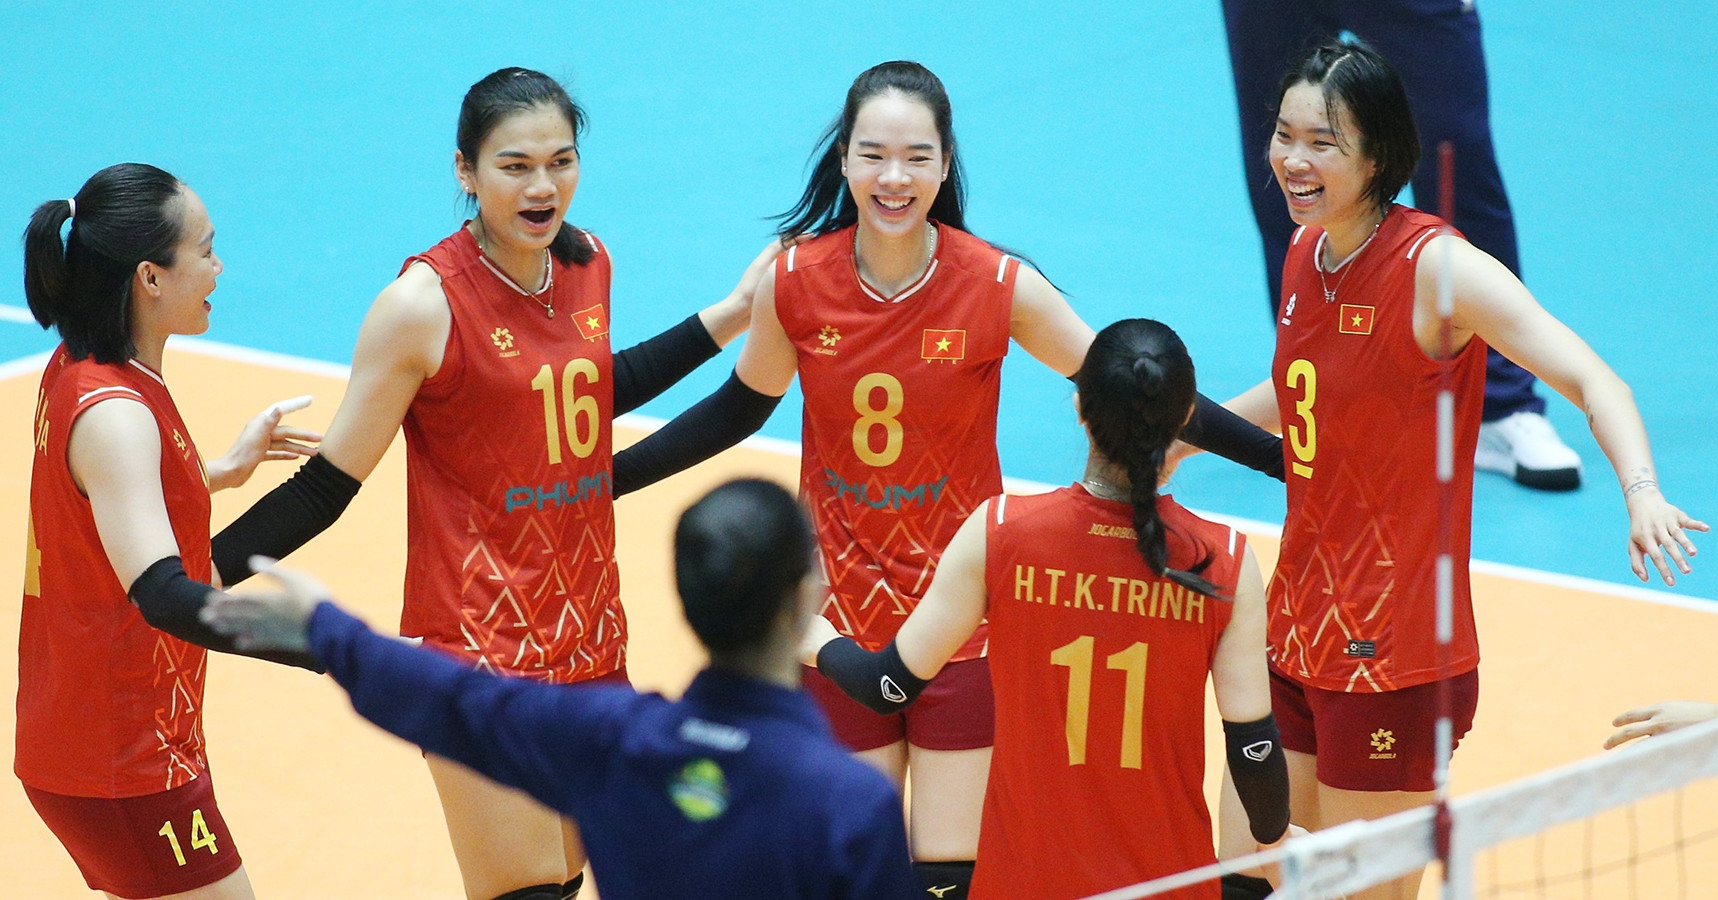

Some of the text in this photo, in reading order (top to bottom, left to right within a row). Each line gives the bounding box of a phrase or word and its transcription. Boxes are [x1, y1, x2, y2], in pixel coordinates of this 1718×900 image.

[531, 358, 600, 465] 16
[852, 372, 904, 467] 8
[1286, 359, 1317, 462] 3
[1087, 523, 1138, 540] JOGARBOL
[1014, 564, 1206, 624] H.T.K.TRINH
[1051, 635, 1149, 770] 11
[158, 809, 219, 867] 14
